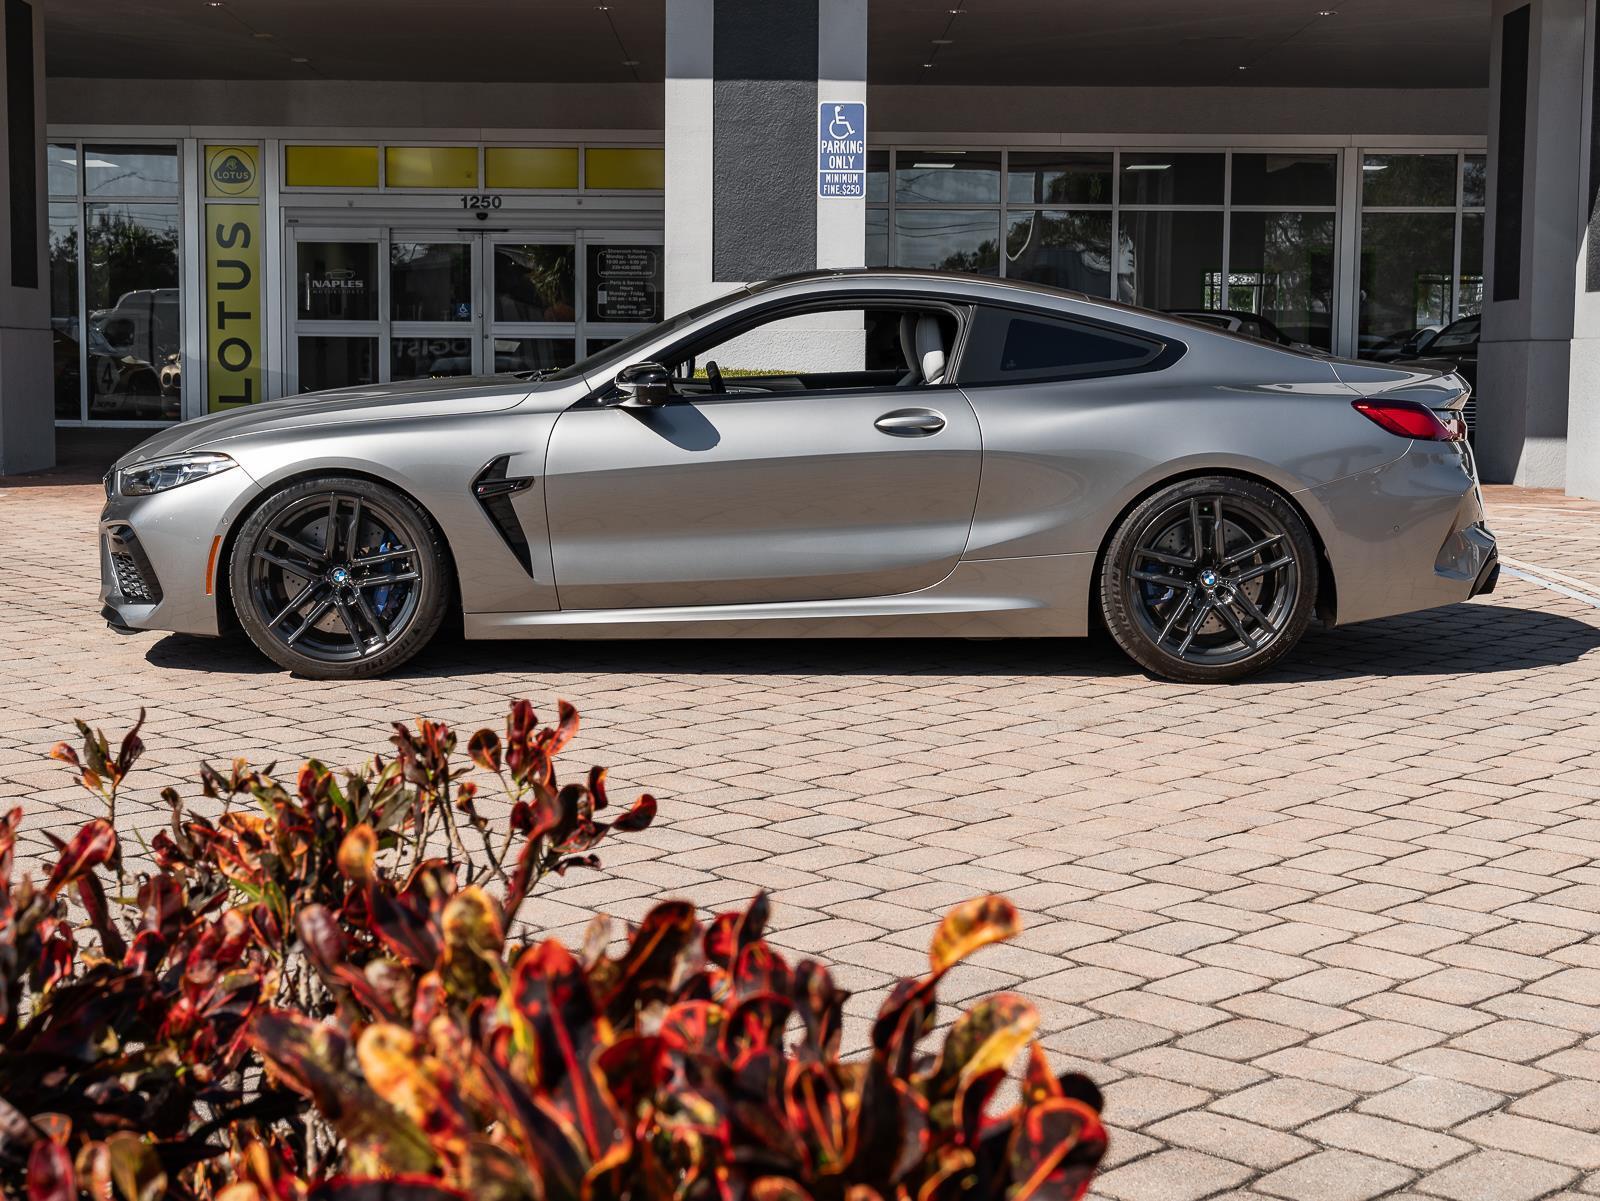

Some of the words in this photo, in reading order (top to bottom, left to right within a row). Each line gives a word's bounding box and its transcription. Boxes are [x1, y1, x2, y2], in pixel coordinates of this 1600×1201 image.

[821, 140, 863, 154] PARKING
[829, 155, 855, 169] ONLY
[217, 171, 249, 180] LOTUS
[825, 173, 858, 183] MINIMUM
[823, 185, 841, 195] FINE
[842, 184, 860, 195] $250
[460, 195, 502, 209] 1250
[312, 279, 364, 288] NAPLES
[216, 222, 252, 404] LOTUS
[102, 362, 114, 392] 4
